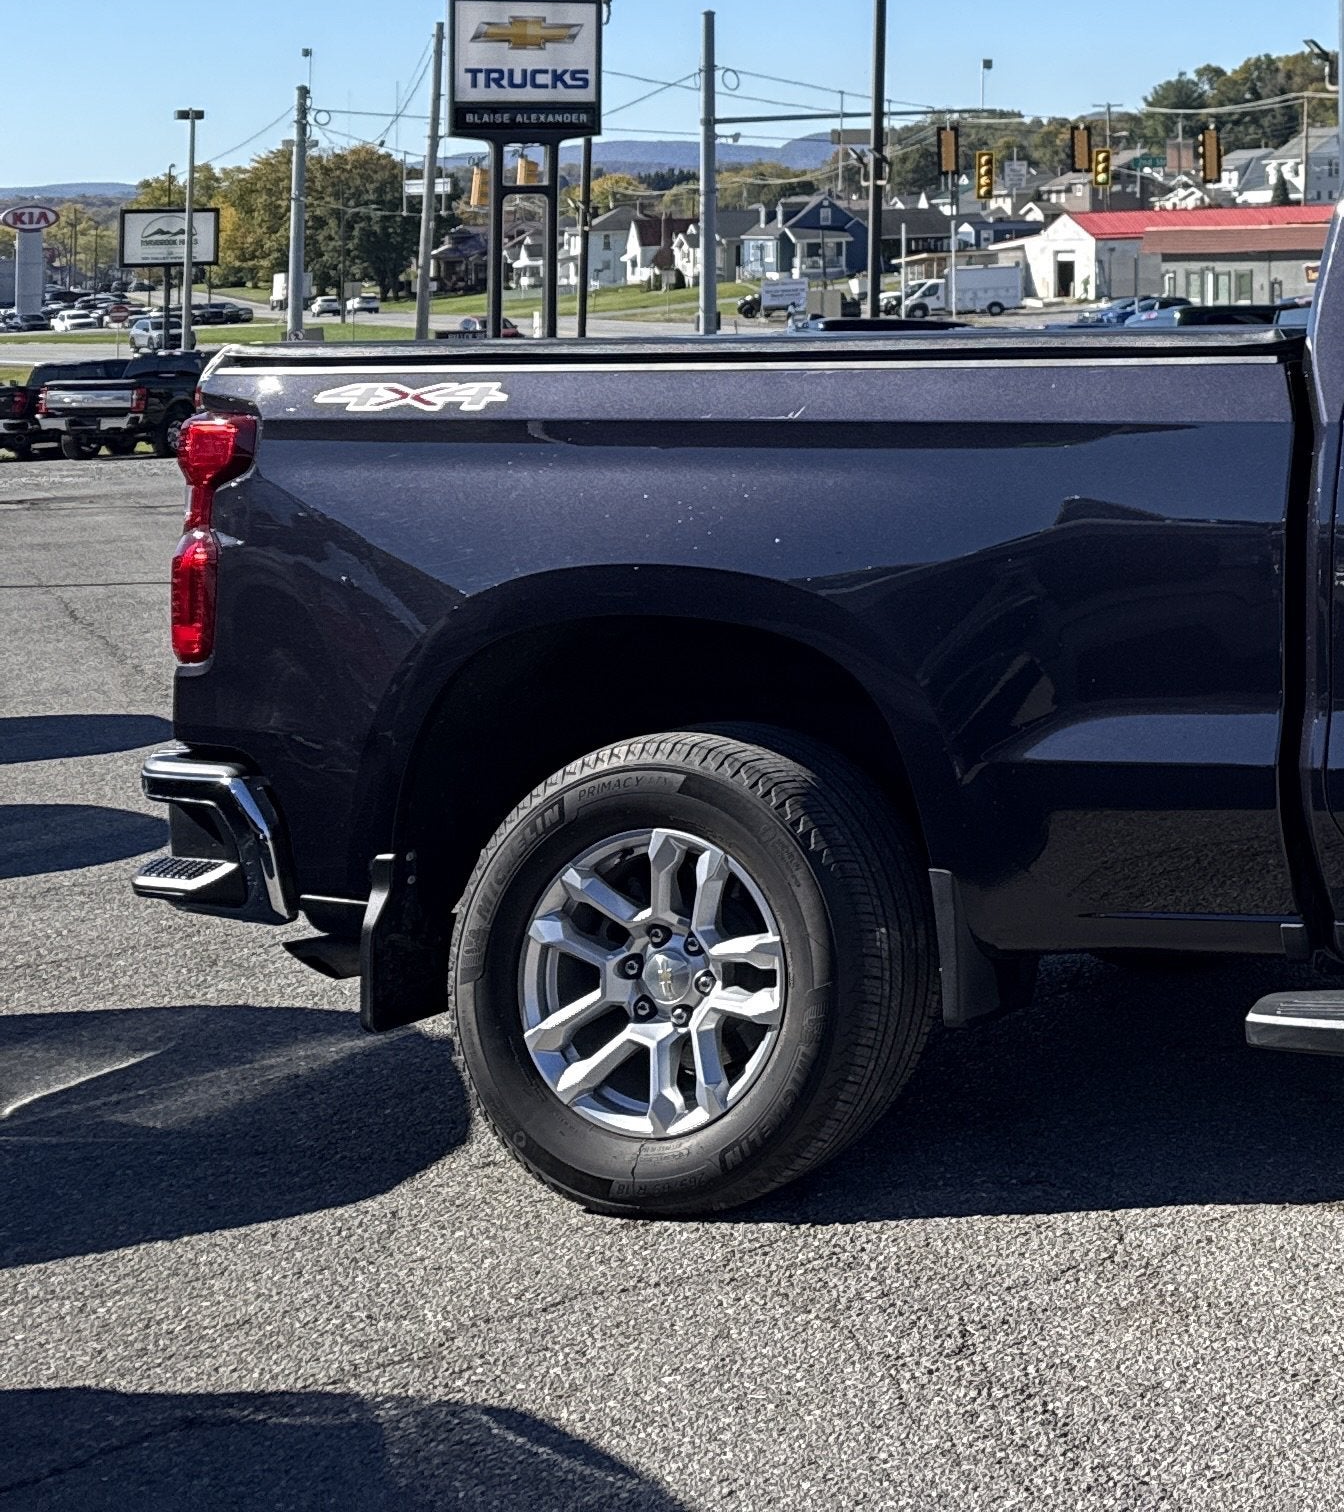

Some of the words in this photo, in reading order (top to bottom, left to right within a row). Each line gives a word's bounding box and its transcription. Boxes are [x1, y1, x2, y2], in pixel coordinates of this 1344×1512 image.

[464, 67, 589, 89] TRUCKS
[465, 112, 511, 124] BLAISE
[515, 113, 588, 124] ALEXANDER
[12, 211, 50, 226] KIA
